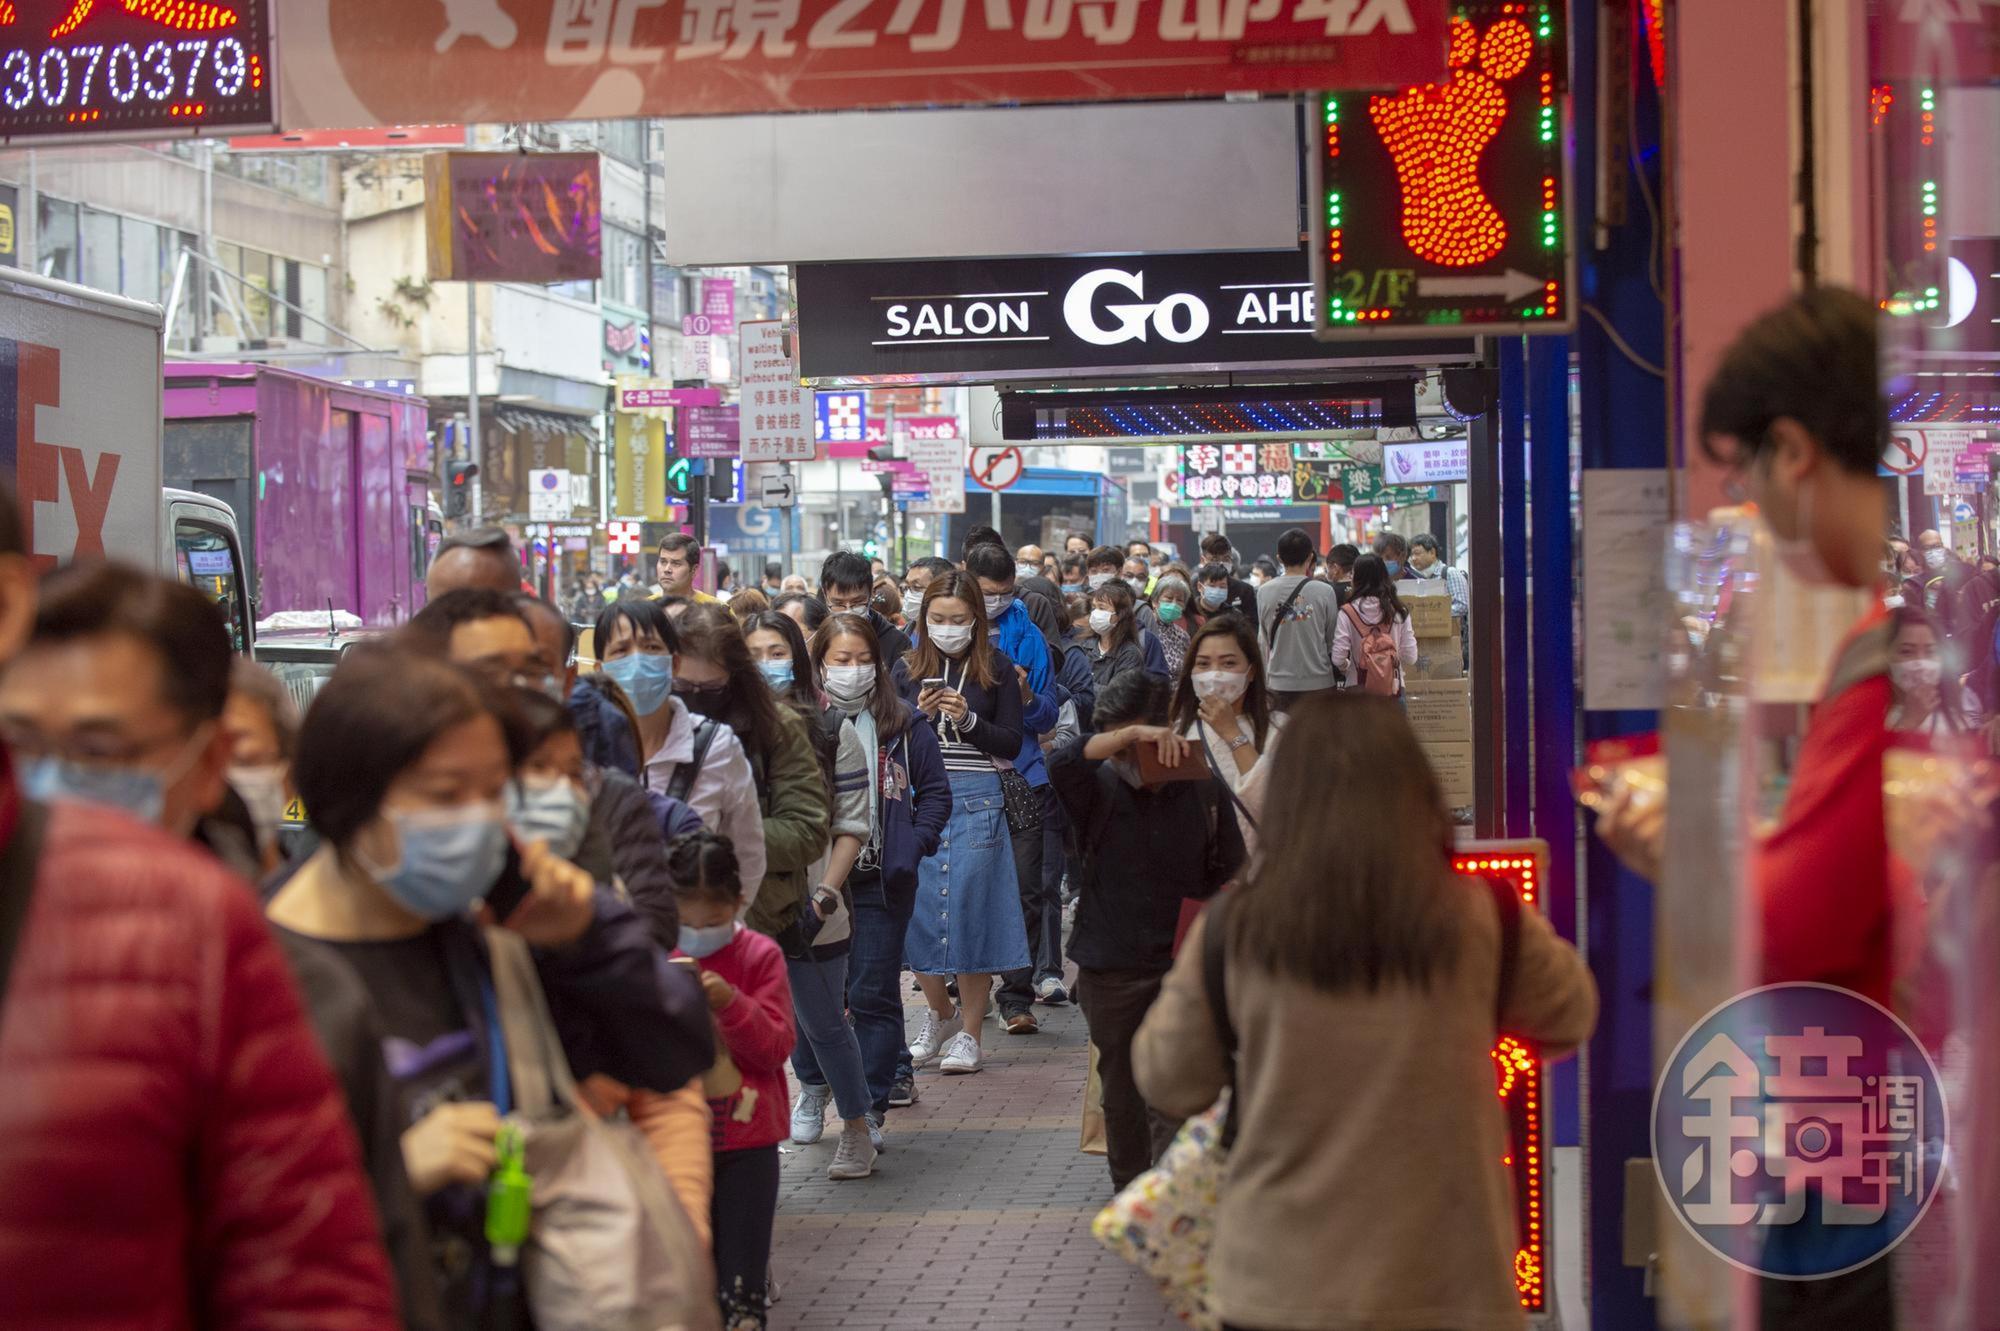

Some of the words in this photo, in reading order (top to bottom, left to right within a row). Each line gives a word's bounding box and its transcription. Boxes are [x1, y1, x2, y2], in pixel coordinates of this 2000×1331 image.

[3, 37, 246, 110] 3070379
[1341, 269, 1416, 308] 2/F
[886, 300, 1030, 337] SALON
[1063, 268, 1210, 345] Go
[748, 344, 778, 355] waiting
[754, 389, 801, 406] 停車等候
[754, 412, 802, 430] 會被檢控
[0, 338, 121, 568] Ex
[748, 436, 808, 454] 而不予警告
[1185, 443, 1221, 475] 幸
[1258, 442, 1292, 473] 福
